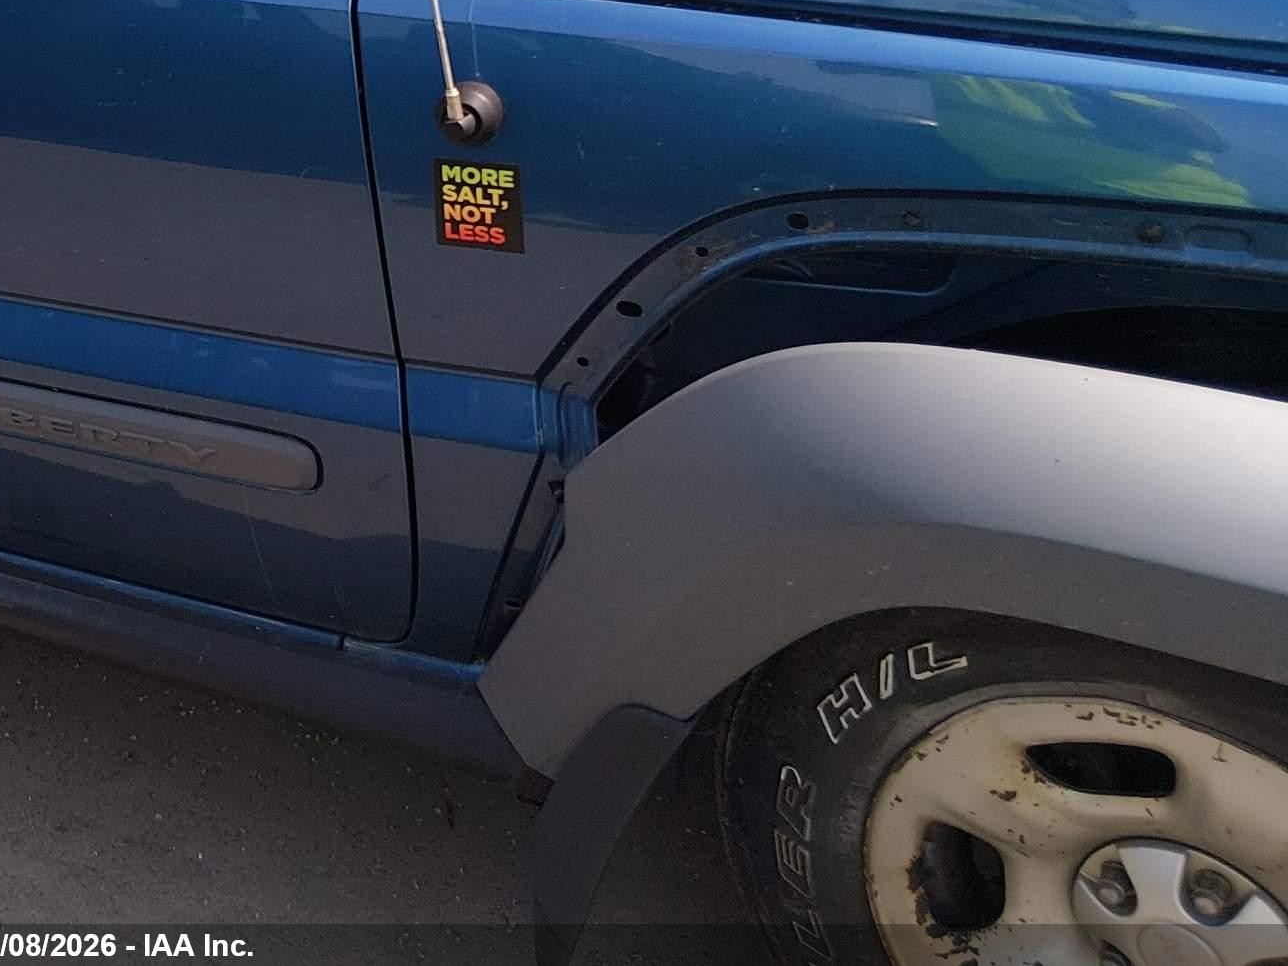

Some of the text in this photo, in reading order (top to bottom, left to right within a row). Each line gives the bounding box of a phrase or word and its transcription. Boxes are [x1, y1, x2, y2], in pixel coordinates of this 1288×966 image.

[441, 164, 515, 188] MORE
[442, 184, 509, 210] SALT,
[443, 203, 497, 225] NOT
[444, 222, 506, 245] LESS
